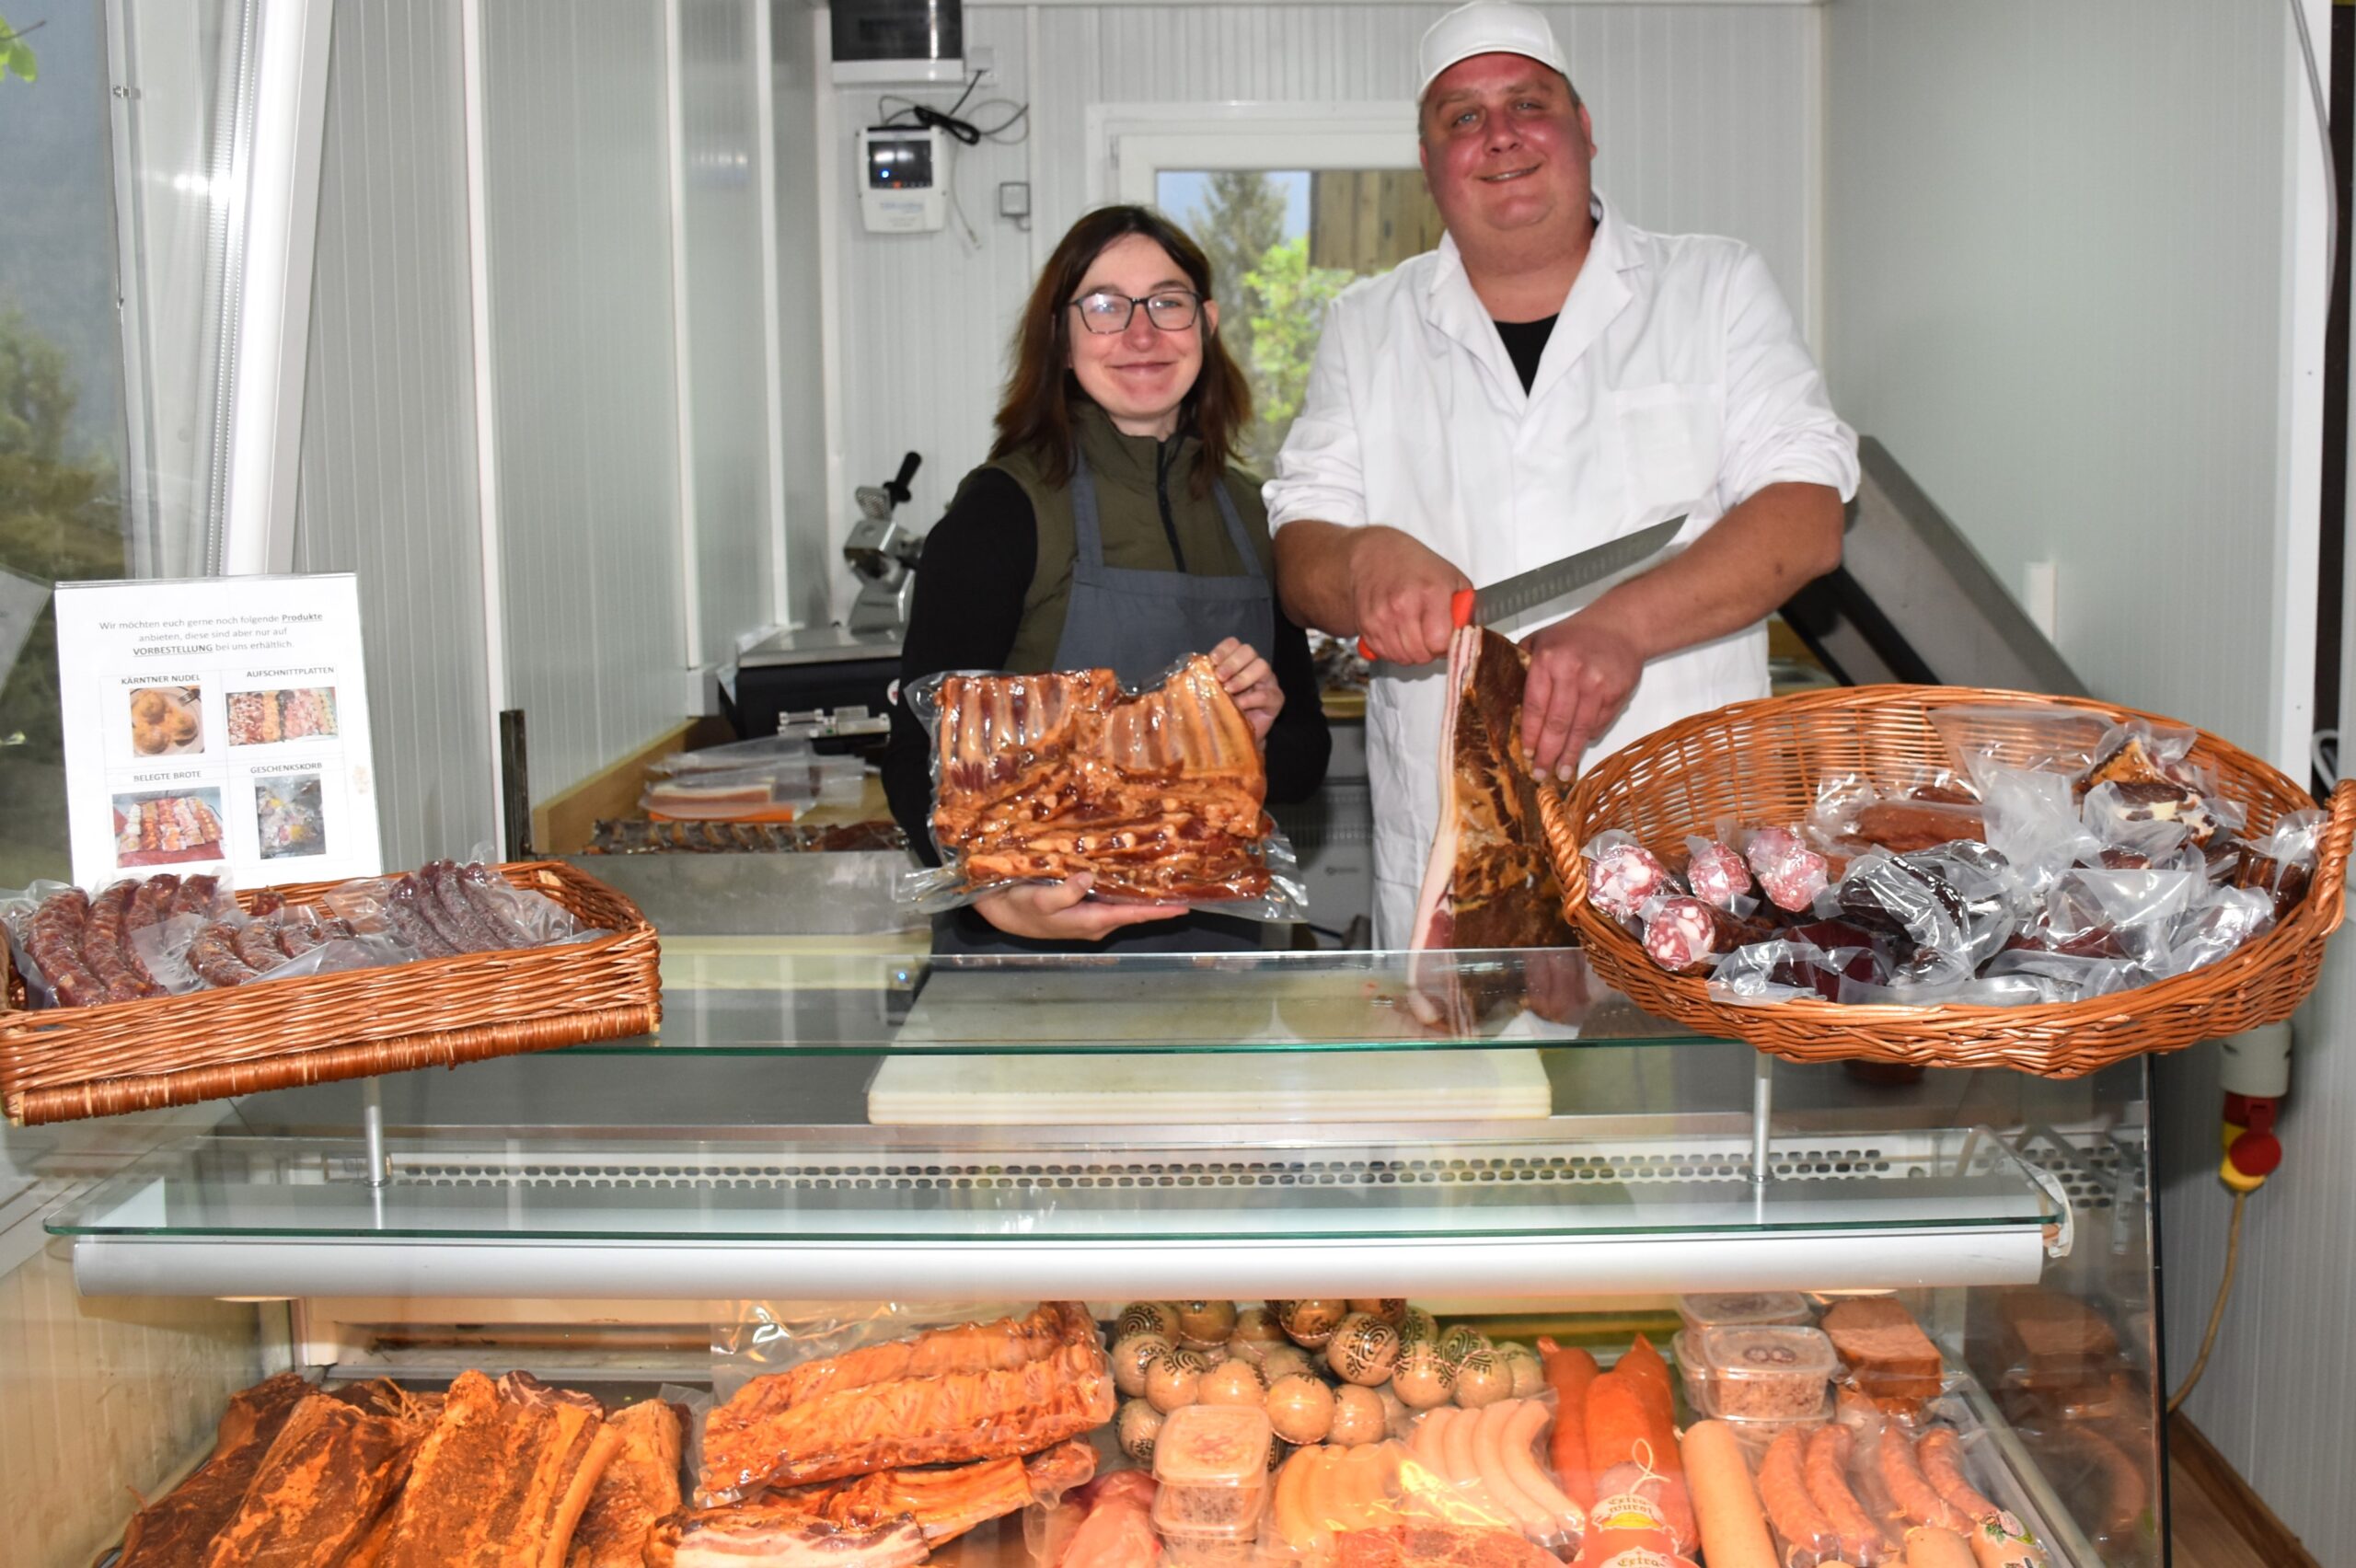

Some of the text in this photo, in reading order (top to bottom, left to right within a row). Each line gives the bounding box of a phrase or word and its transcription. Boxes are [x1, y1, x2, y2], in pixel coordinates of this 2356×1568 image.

[99, 613, 323, 630] Wir möchten euch gerne noch folgende Produkte
[139, 627, 287, 643] anbieten, diese sind aber nur auf
[133, 644, 214, 656] VORBESTELLUNG
[215, 643, 230, 651] bei
[250, 640, 294, 650] erhältlich.
[247, 666, 335, 678] AUFSCHNITTPLATTEN
[171, 674, 201, 684] NUDEL
[250, 762, 323, 774] GESCHENKSKORB
[133, 770, 202, 782] BELEGTE BROTE
